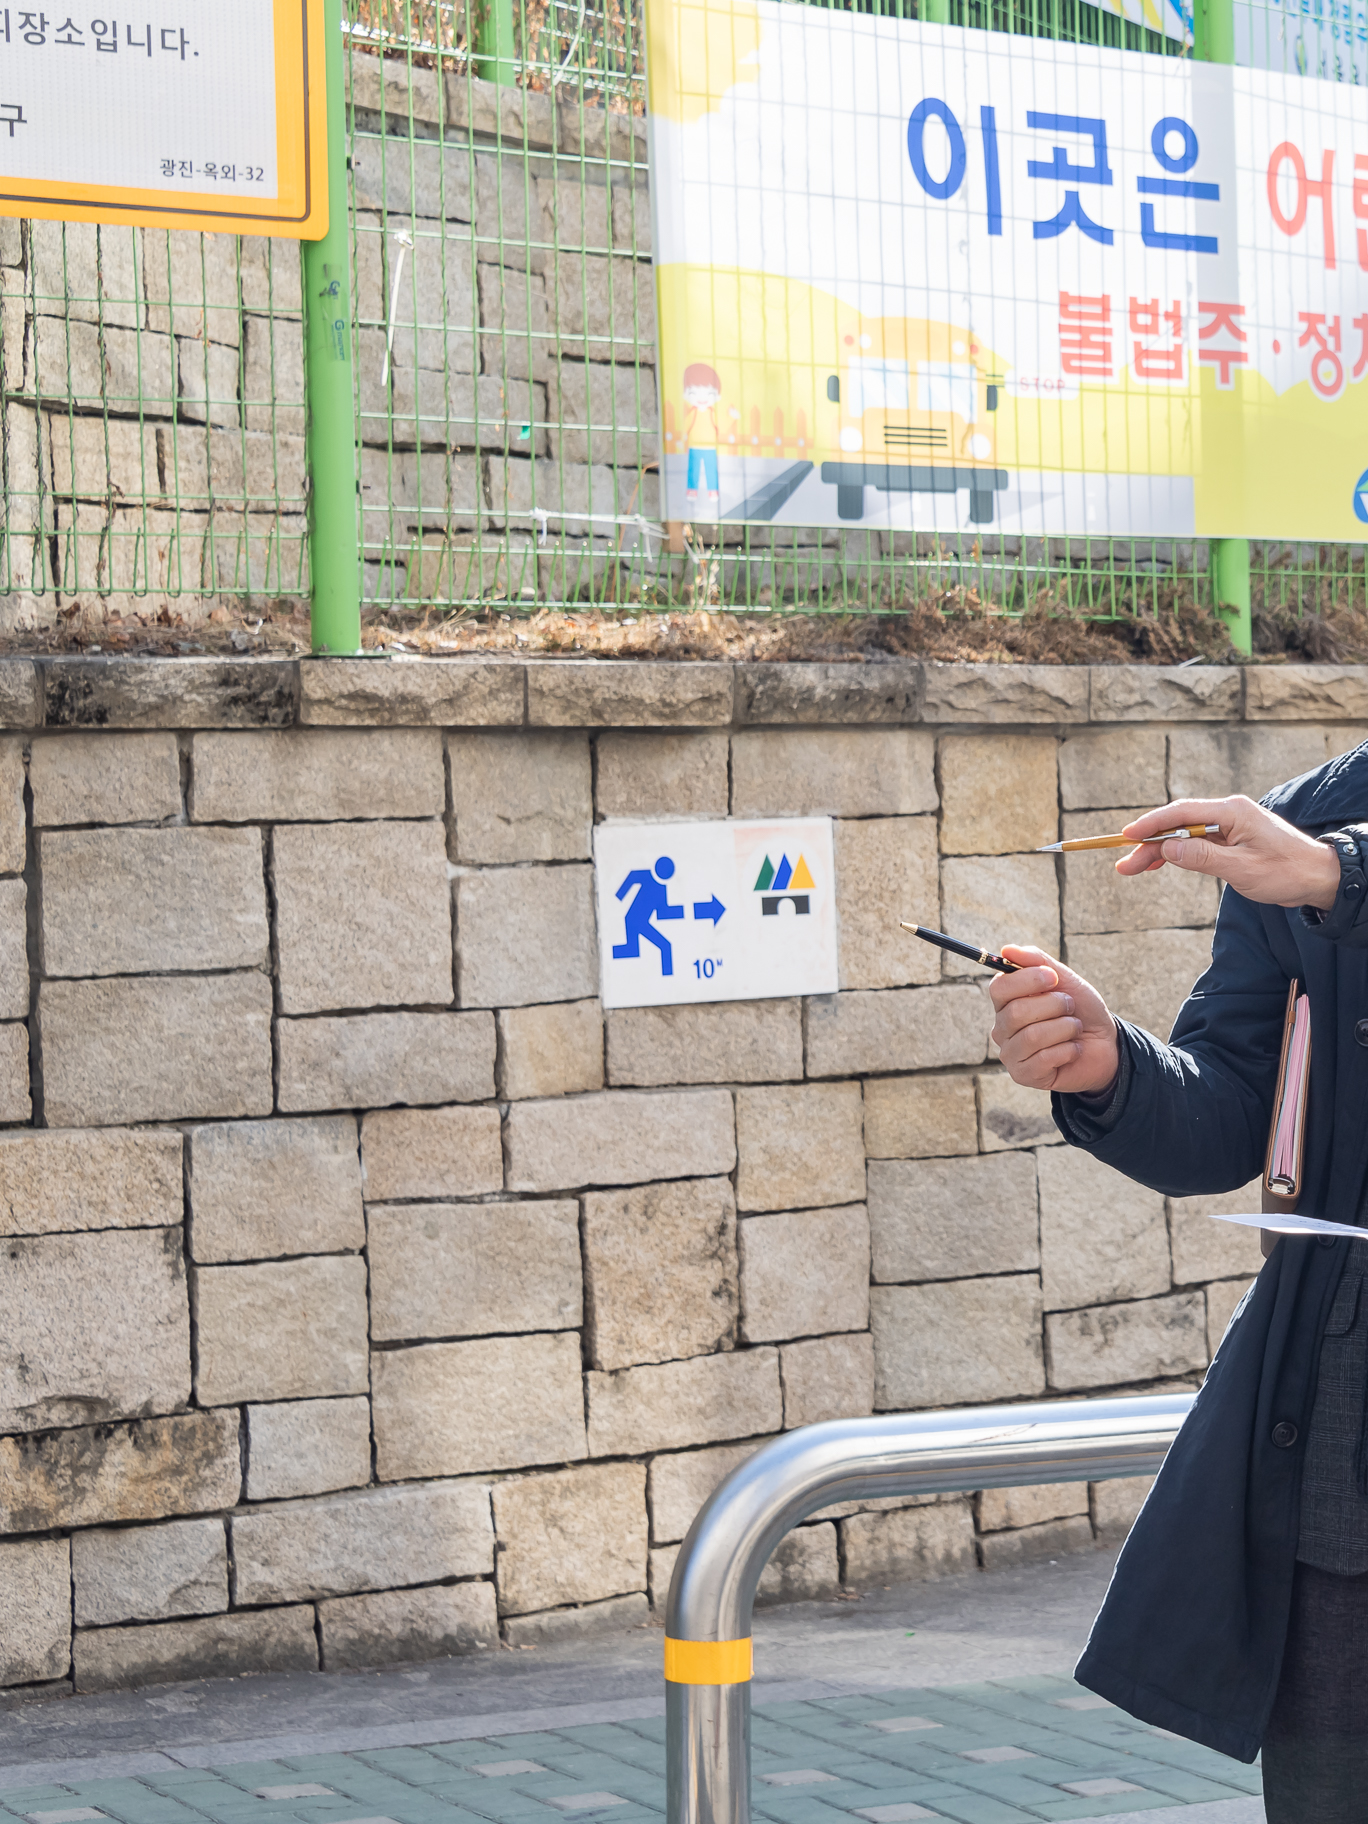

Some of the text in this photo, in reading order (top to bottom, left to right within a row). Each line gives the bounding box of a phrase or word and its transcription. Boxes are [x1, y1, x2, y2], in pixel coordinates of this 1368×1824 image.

[160, 158, 265, 183] 광진-옥외-32
[907, 97, 1221, 255] 이곳은
[1020, 376, 1066, 393] STOP
